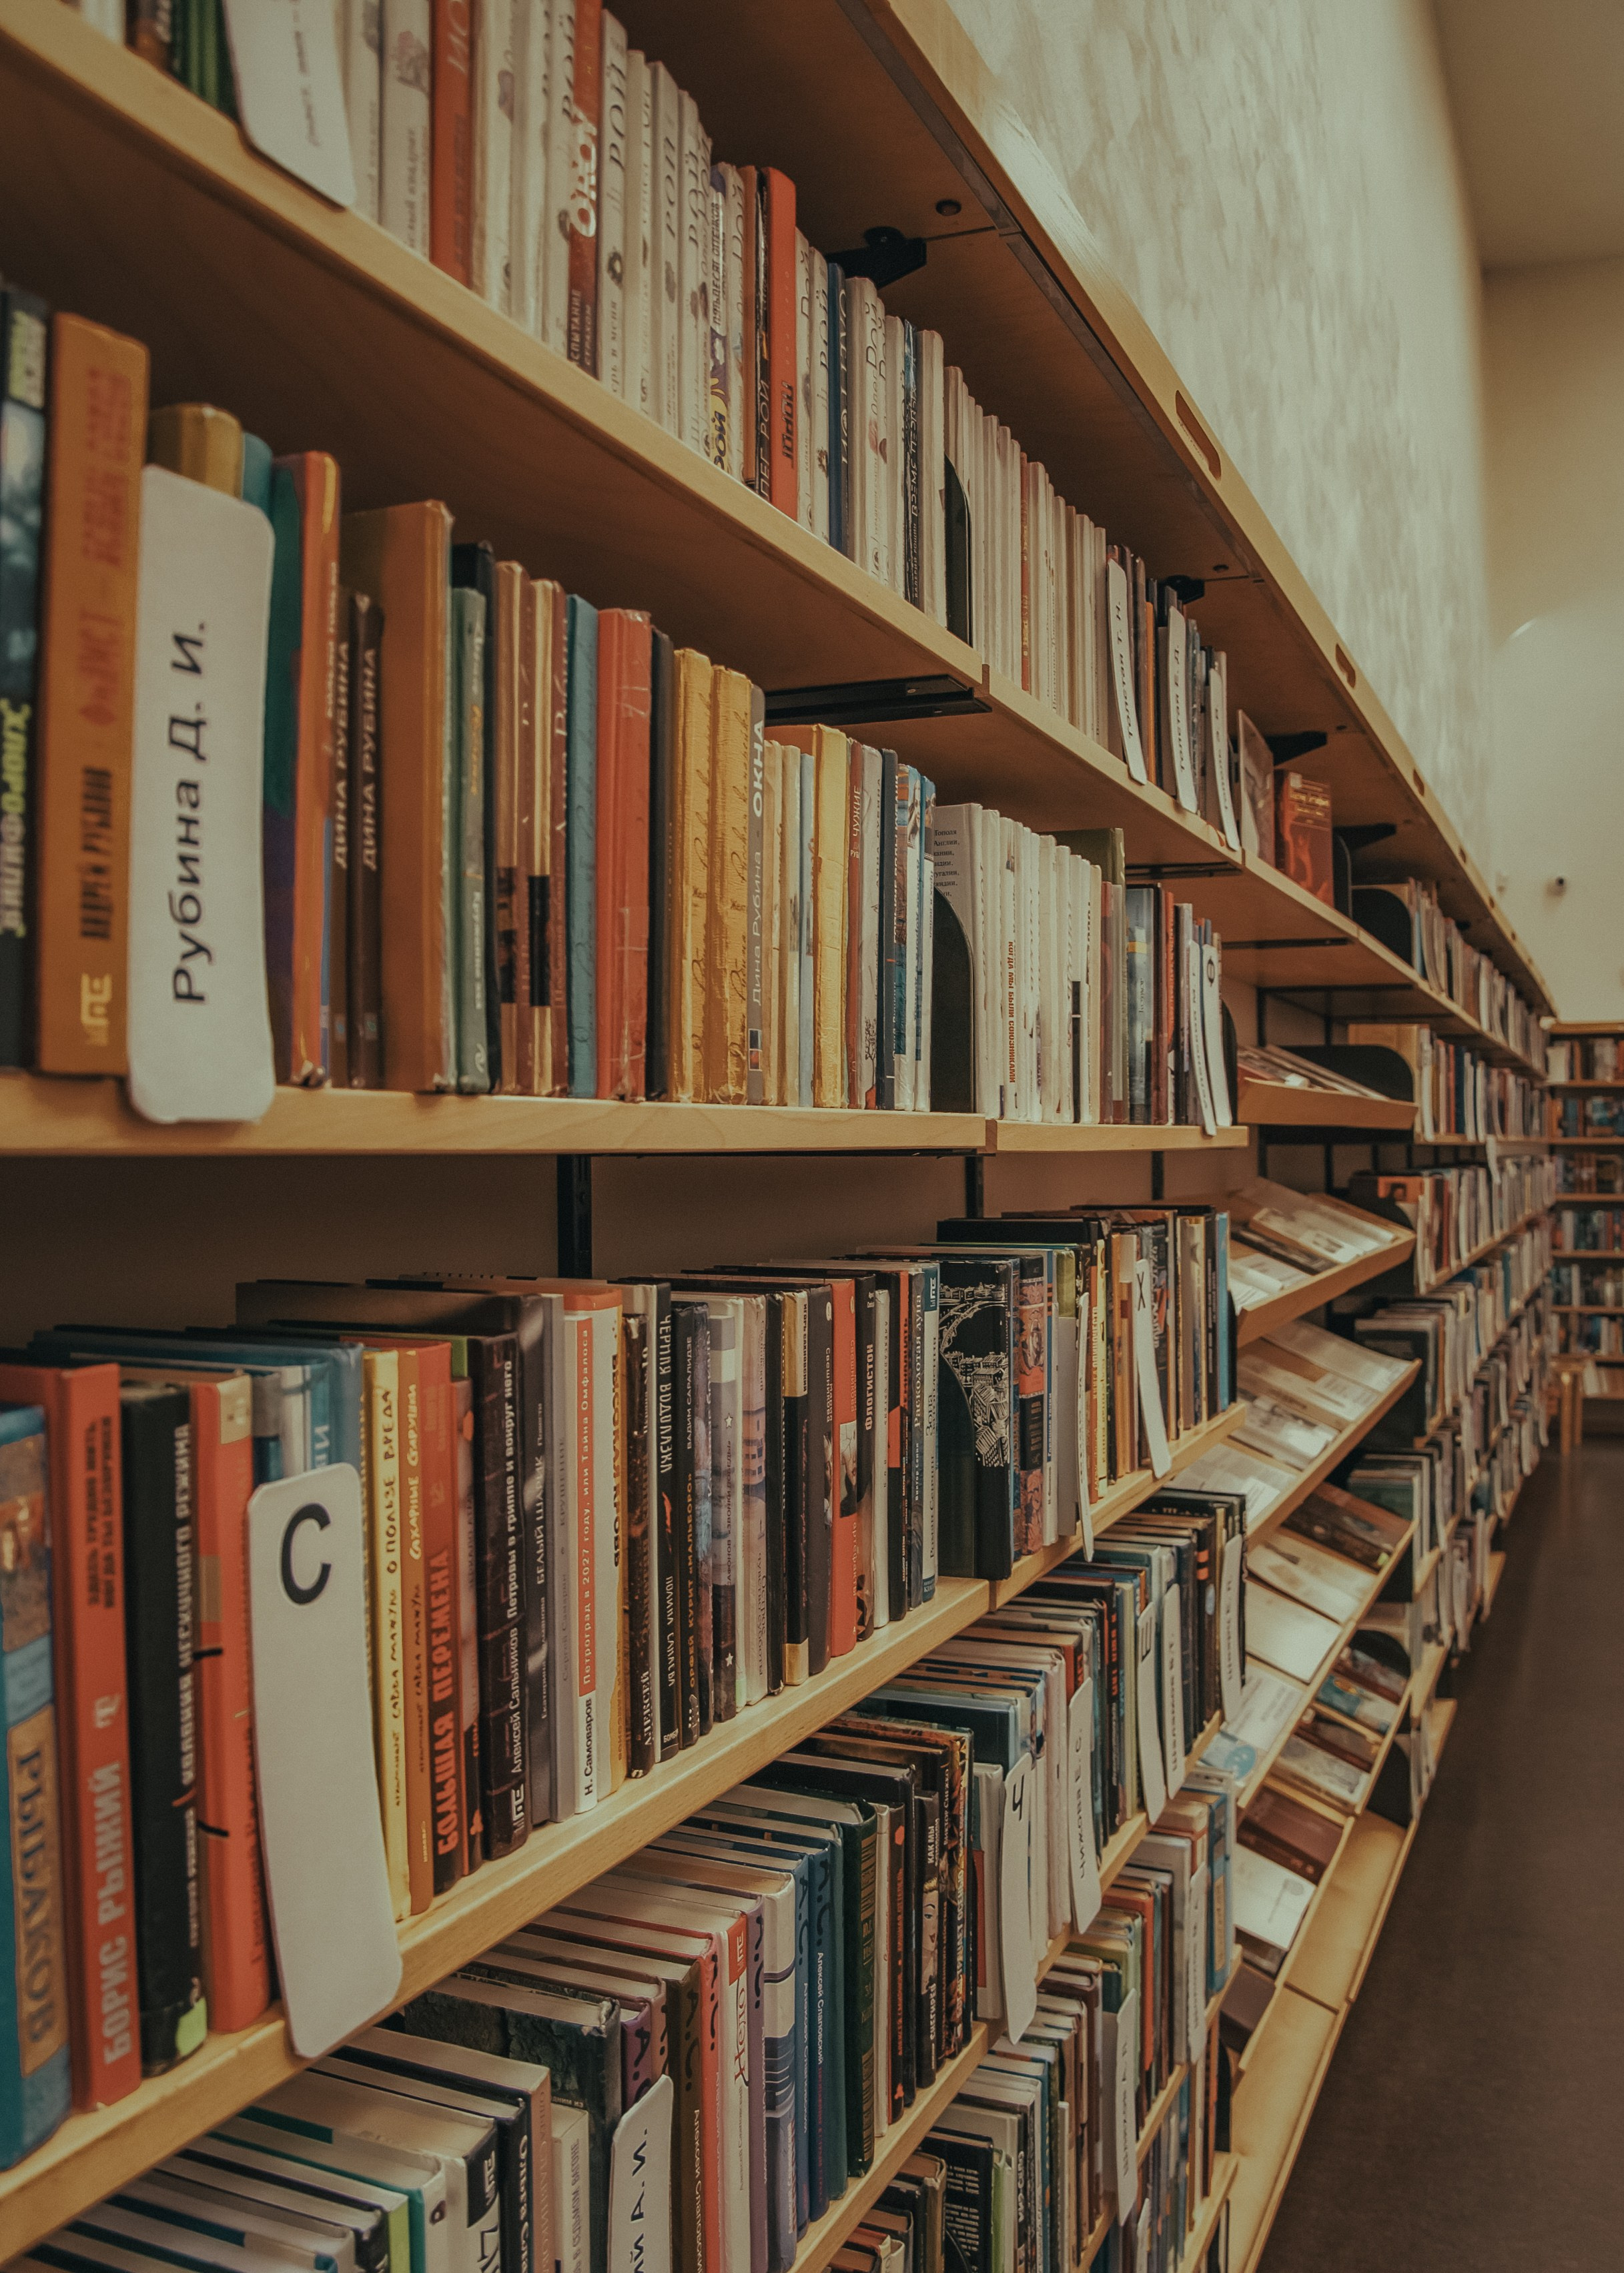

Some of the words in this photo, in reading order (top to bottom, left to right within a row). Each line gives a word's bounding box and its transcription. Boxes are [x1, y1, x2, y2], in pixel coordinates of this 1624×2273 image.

[711, 203, 720, 258] ОТТЕНКОВ
[712, 261, 721, 326] ПЯТЬДЕСЯТ
[759, 379, 769, 436] РОЙ
[1114, 601, 1122, 621] Н.
[169, 621, 205, 676] И.
[336, 640, 350, 770] РУБИНА
[362, 647, 377, 773] РУБИНА
[1119, 652, 1134, 739] Толстая
[168, 701, 208, 763] Д.
[1174, 693, 1186, 773] Толстая
[753, 720, 763, 819] ОКНА
[334, 779, 348, 869] ДИНА
[362, 783, 377, 871] ДИНА
[853, 785, 861, 837] ЧУЖИЕ
[168, 779, 212, 1005] Рубина
[751, 851, 761, 937] Рубина
[752, 945, 762, 1007] Дина
[1007, 941, 1016, 969] КОГДА
[1008, 971, 1016, 988] МЫ
[1205, 957, 1216, 987] Ф
[1008, 1020, 1016, 1083] СОЮЗНИКАМИ
[914, 1294, 923, 1332] луна
[1136, 1272, 1146, 1311] Х
[504, 1360, 514, 1398] него
[580, 1329, 590, 1411] Омфалоса
[685, 1336, 693, 1406] САРАЛИДЗЕ
[913, 1336, 921, 1428] Расколотая
[504, 1402, 518, 1458] вокруг
[659, 1384, 673, 1473] ВОДОЛАЗКА
[505, 1460, 514, 1472] и
[534, 1456, 544, 1521] ШАРИК
[384, 1475, 396, 1553] ПОЛЬЗЕ
[506, 1475, 518, 1532] гриппе
[582, 1501, 590, 1542] году,
[686, 1472, 695, 1574] «МАЛЬБОРО»
[280, 1502, 332, 1605] С
[386, 1560, 398, 1574] О
[506, 1536, 516, 1546] в
[533, 1525, 544, 1584] БЕЛЫЙ
[582, 1548, 590, 1584] 2027
[506, 1550, 519, 1619] Петровы
[560, 1574, 569, 1632] Самарин
[583, 1590, 590, 1599] в
[665, 1576, 675, 1625] ПОЛИНА
[429, 1548, 454, 1703] ПЕРЕМЕНА
[582, 1603, 592, 1685] Петроград
[1141, 1617, 1152, 1663] Ш
[507, 1627, 521, 1710] Сальников
[561, 1635, 570, 1682] Сергей
[688, 1634, 696, 1688] ОРФЕЙ
[583, 1698, 594, 1777] Самоваров
[641, 1671, 653, 1746] АЛЕКСЕЙ
[508, 1712, 523, 1775] Алексей
[433, 1711, 460, 1855] БОЛЬШАЯ
[584, 1779, 593, 1796] Н.
[1012, 1774, 1024, 1822] Ч
[87, 1761, 127, 1925] РЫЖИЙ
[926, 1843, 935, 1865] КАК
[927, 1825, 935, 1843] МЫ
[16, 1747, 55, 2043] РЫБАКОВ
[98, 1936, 133, 2065] БОРИС
[815, 1951, 825, 1997] Алексей
[816, 1999, 826, 2065] Слаповский
[630, 2128, 648, 2177] И.
[693, 2109, 701, 2178] Алексей
[519, 2134, 528, 2221] Ольга
[630, 2181, 645, 2223] А.
